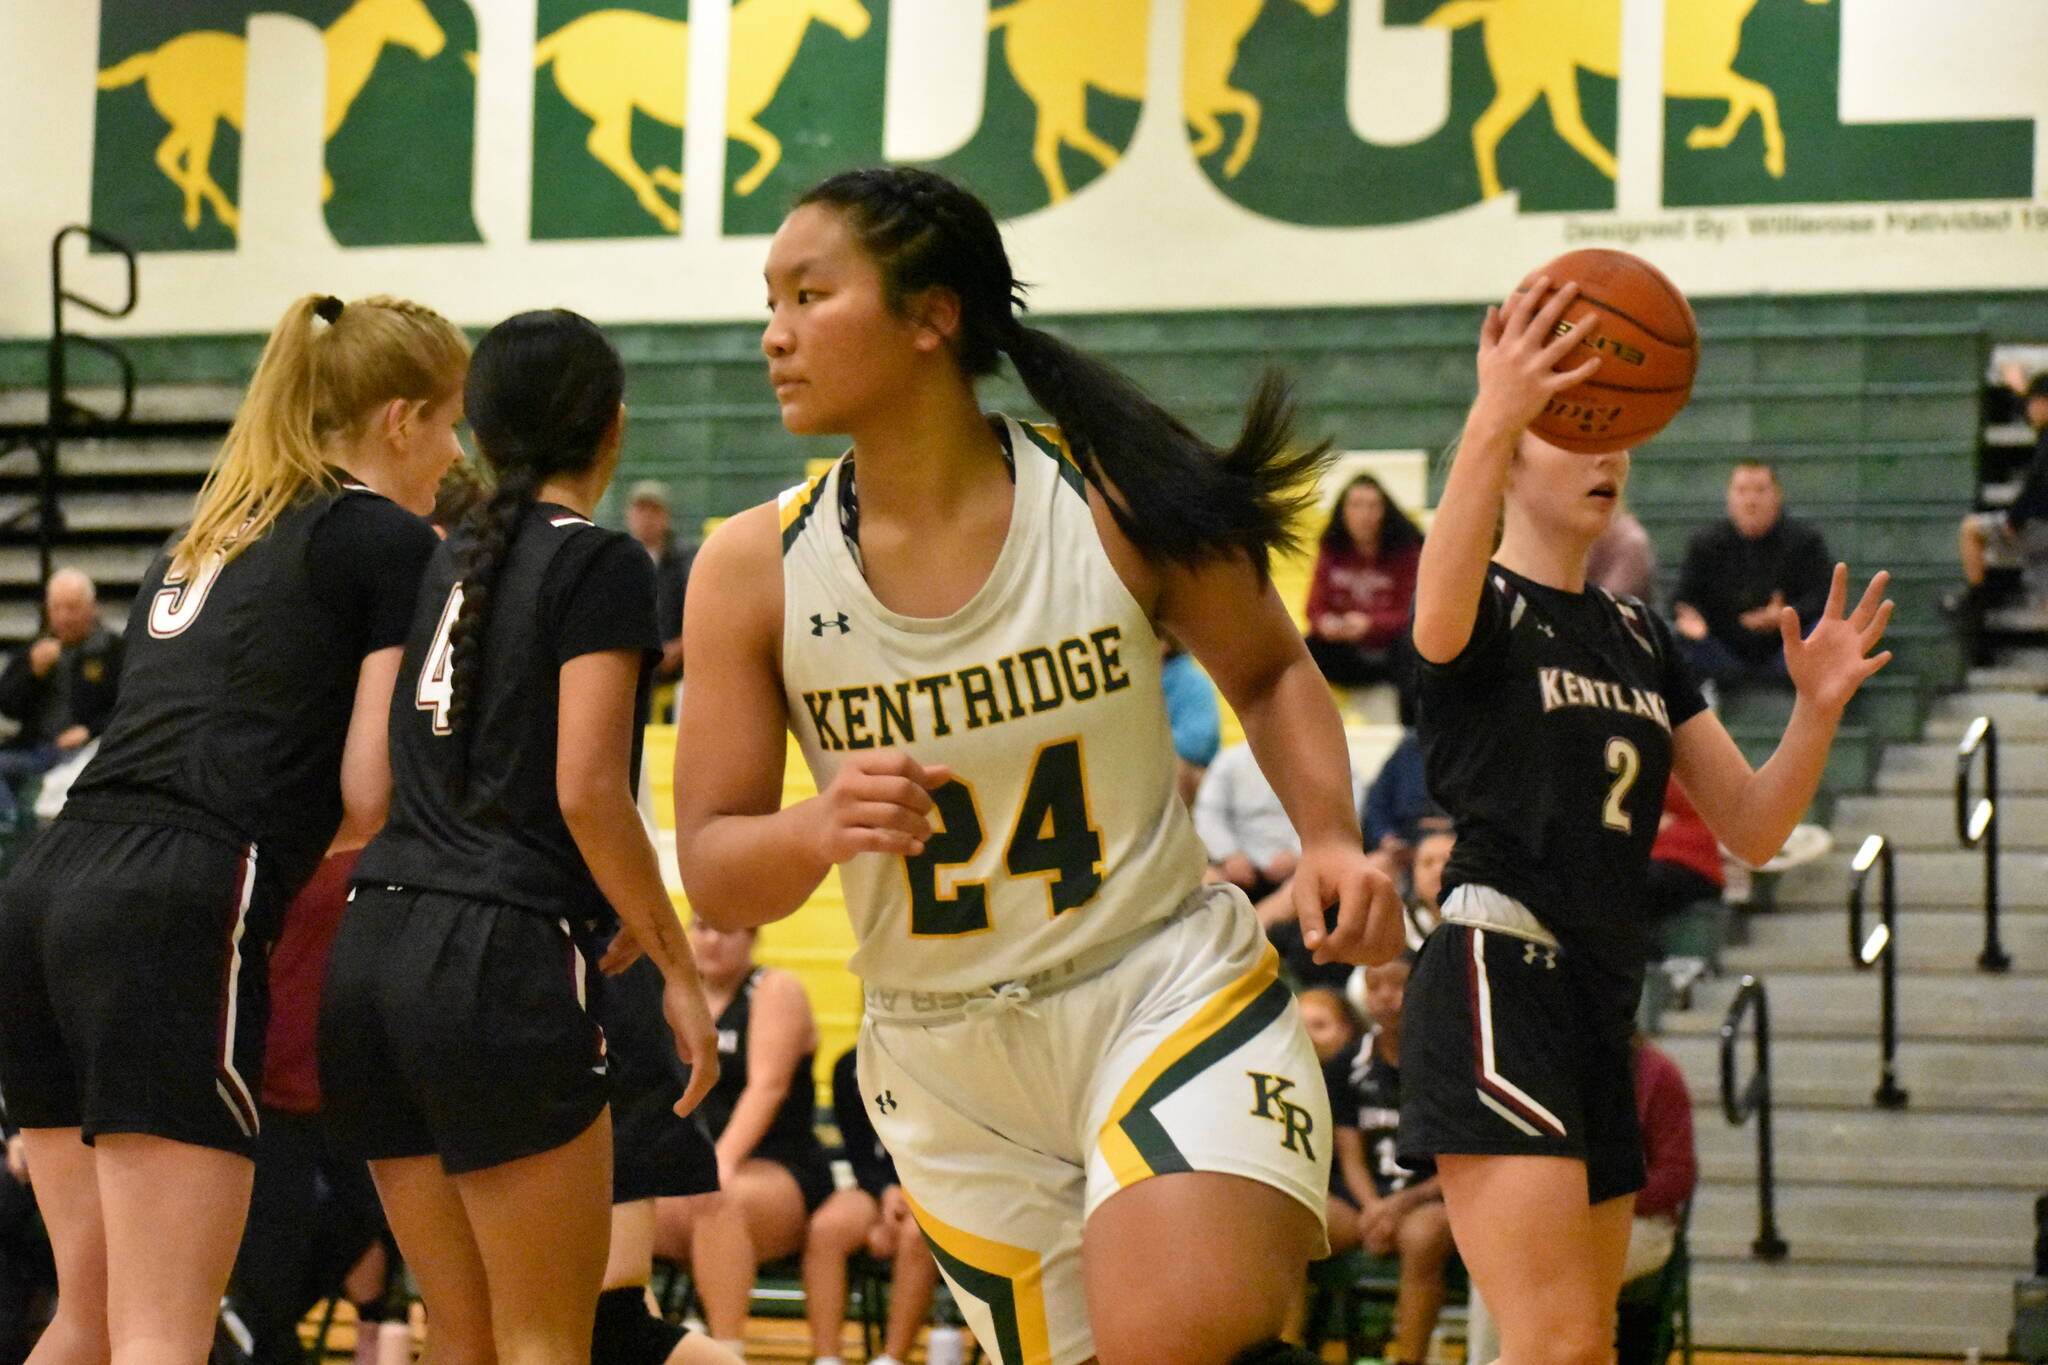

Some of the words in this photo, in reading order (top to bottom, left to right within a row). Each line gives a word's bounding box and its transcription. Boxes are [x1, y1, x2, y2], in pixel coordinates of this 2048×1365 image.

[415, 581, 464, 736] 4
[802, 624, 1132, 751] KENTRIDGE
[902, 734, 1110, 938] 24
[1602, 735, 1641, 836] 2
